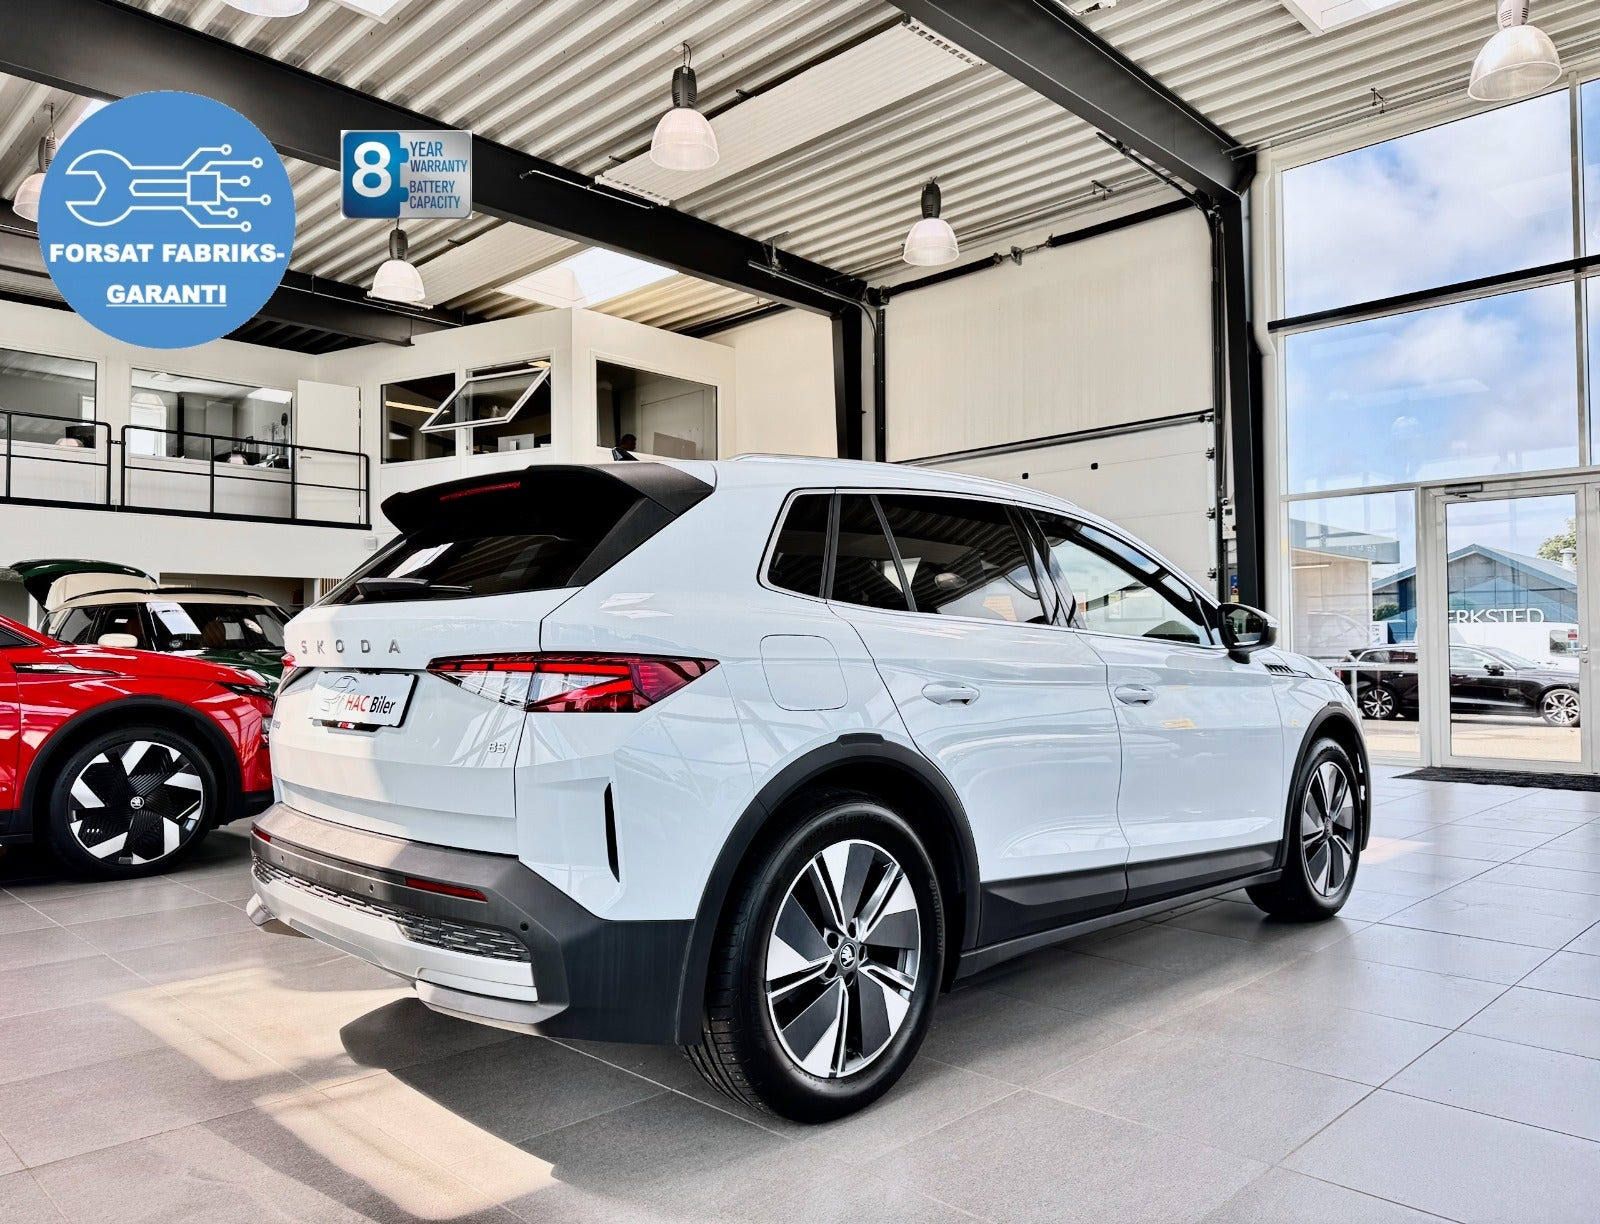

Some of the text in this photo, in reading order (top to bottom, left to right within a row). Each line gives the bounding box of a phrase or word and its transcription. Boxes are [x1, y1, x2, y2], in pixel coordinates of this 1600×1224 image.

[345, 693, 396, 715] HAC Biler
[488, 742, 507, 754] 85
